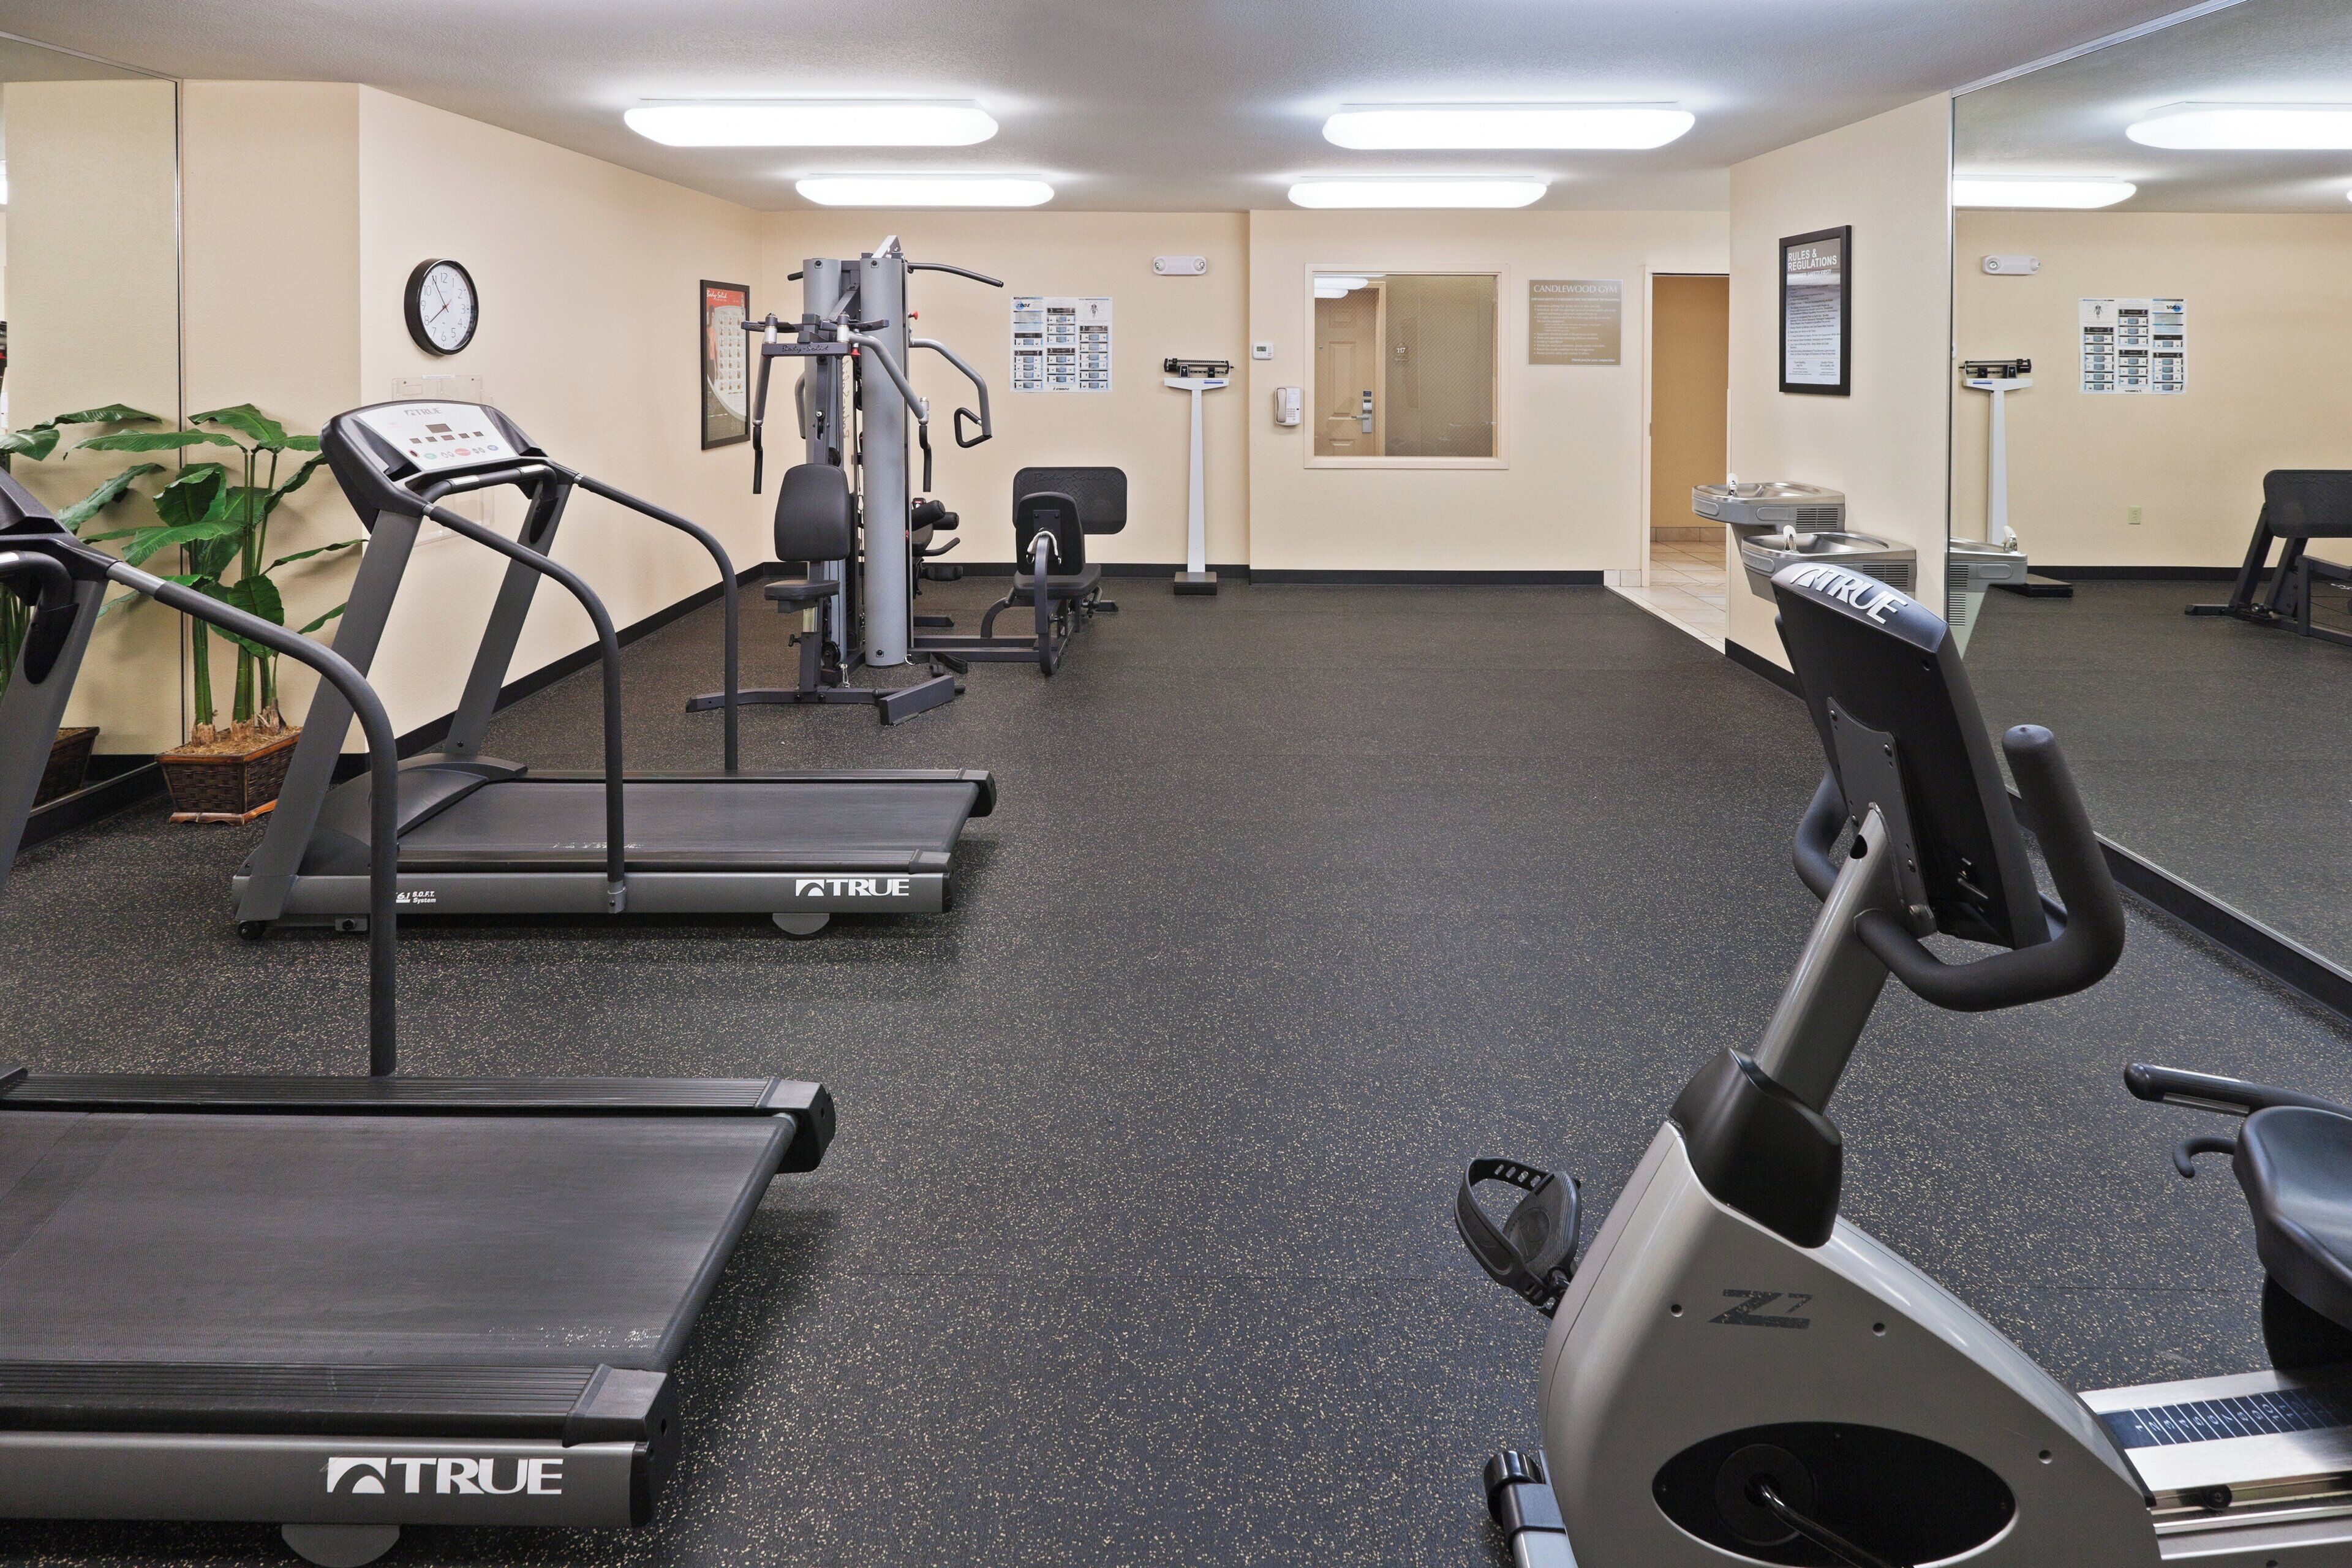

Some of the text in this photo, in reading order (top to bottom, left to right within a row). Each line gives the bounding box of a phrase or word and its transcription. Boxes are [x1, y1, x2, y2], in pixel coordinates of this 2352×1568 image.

[1788, 249, 1817, 262] RULES &
[1788, 255, 1837, 271] REGULATIONS
[440, 273, 448, 284] 12
[452, 278, 454, 288] 1
[424, 285, 431, 296] 10
[458, 289, 462, 299] 2
[421, 301, 426, 311] 9
[461, 304, 466, 314] 3
[424, 315, 430, 326] 8
[458, 318, 462, 328] 4
[432, 327, 436, 337] 7
[441, 331, 446, 342] 6
[451, 328, 456, 337] 5
[782, 344, 829, 353] Body-Solid
[1033, 472, 1107, 483] Body-Solid
[1815, 569, 1908, 625] TRUE
[826, 879, 909, 896] TRUE
[2149, 1422, 2162, 1431] 2
[2163, 1420, 2176, 1430] 3
[2178, 1419, 2190, 1428] 4
[2193, 1416, 2204, 1426] 5
[2207, 1415, 2219, 1425] 6
[2222, 1414, 2233, 1423] 7
[2236, 1411, 2249, 1422] 8
[2252, 1410, 2264, 1420] 9
[2262, 1404, 2280, 1422] 10
[2278, 1404, 2294, 1419] 11
[390, 1457, 564, 1494] TRUE
